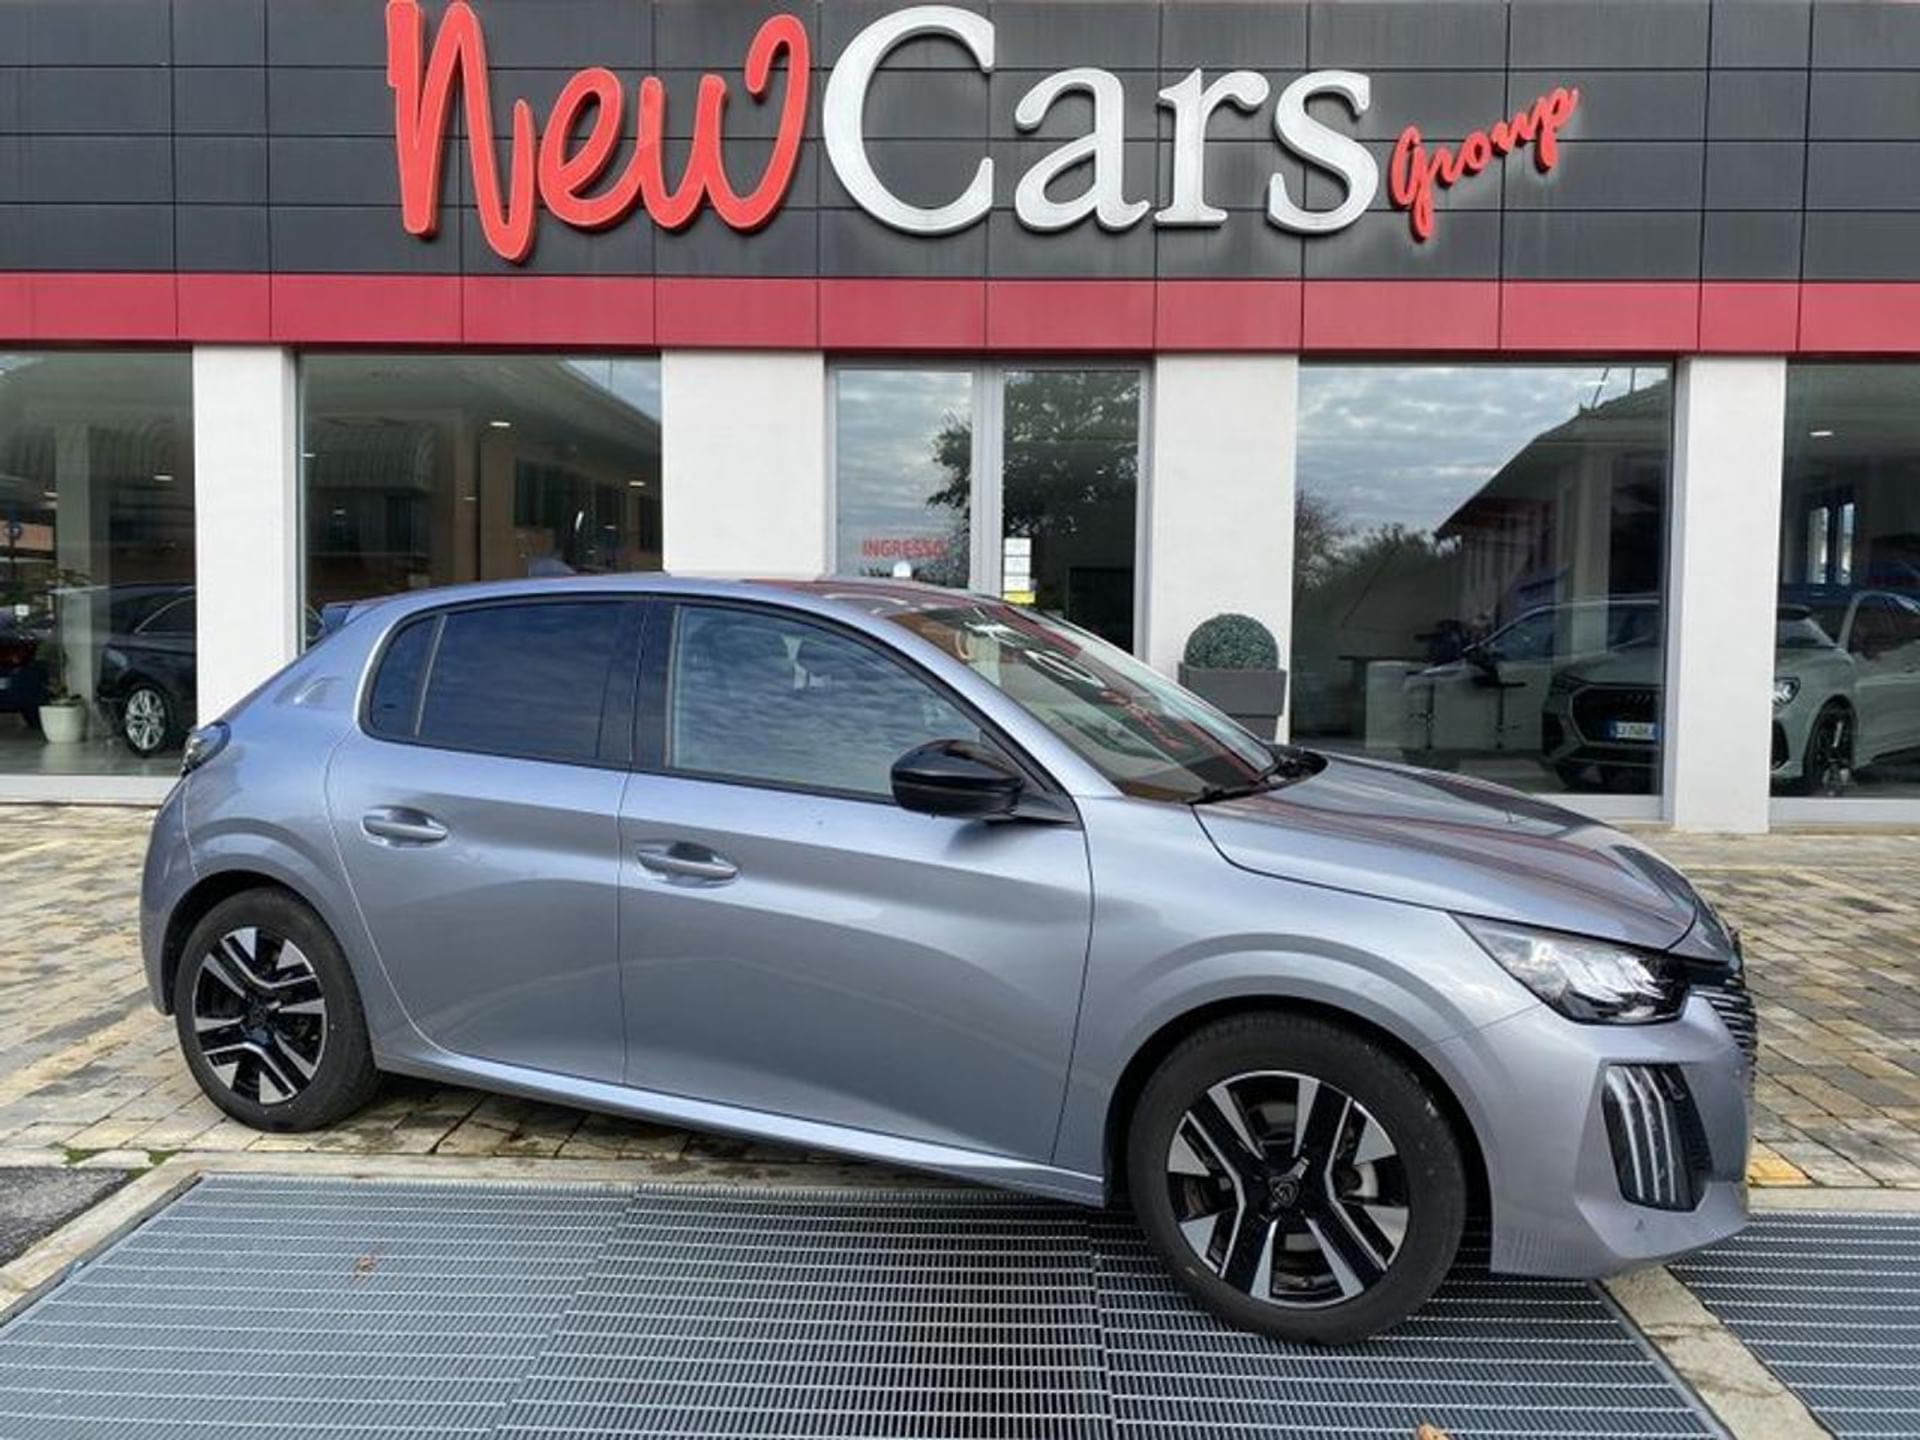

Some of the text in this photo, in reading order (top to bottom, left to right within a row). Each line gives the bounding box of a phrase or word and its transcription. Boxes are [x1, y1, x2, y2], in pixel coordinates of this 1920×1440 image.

[386, 0, 810, 262] New
[823, 4, 1379, 235] Cars
[863, 539, 946, 558] INGRESSO
